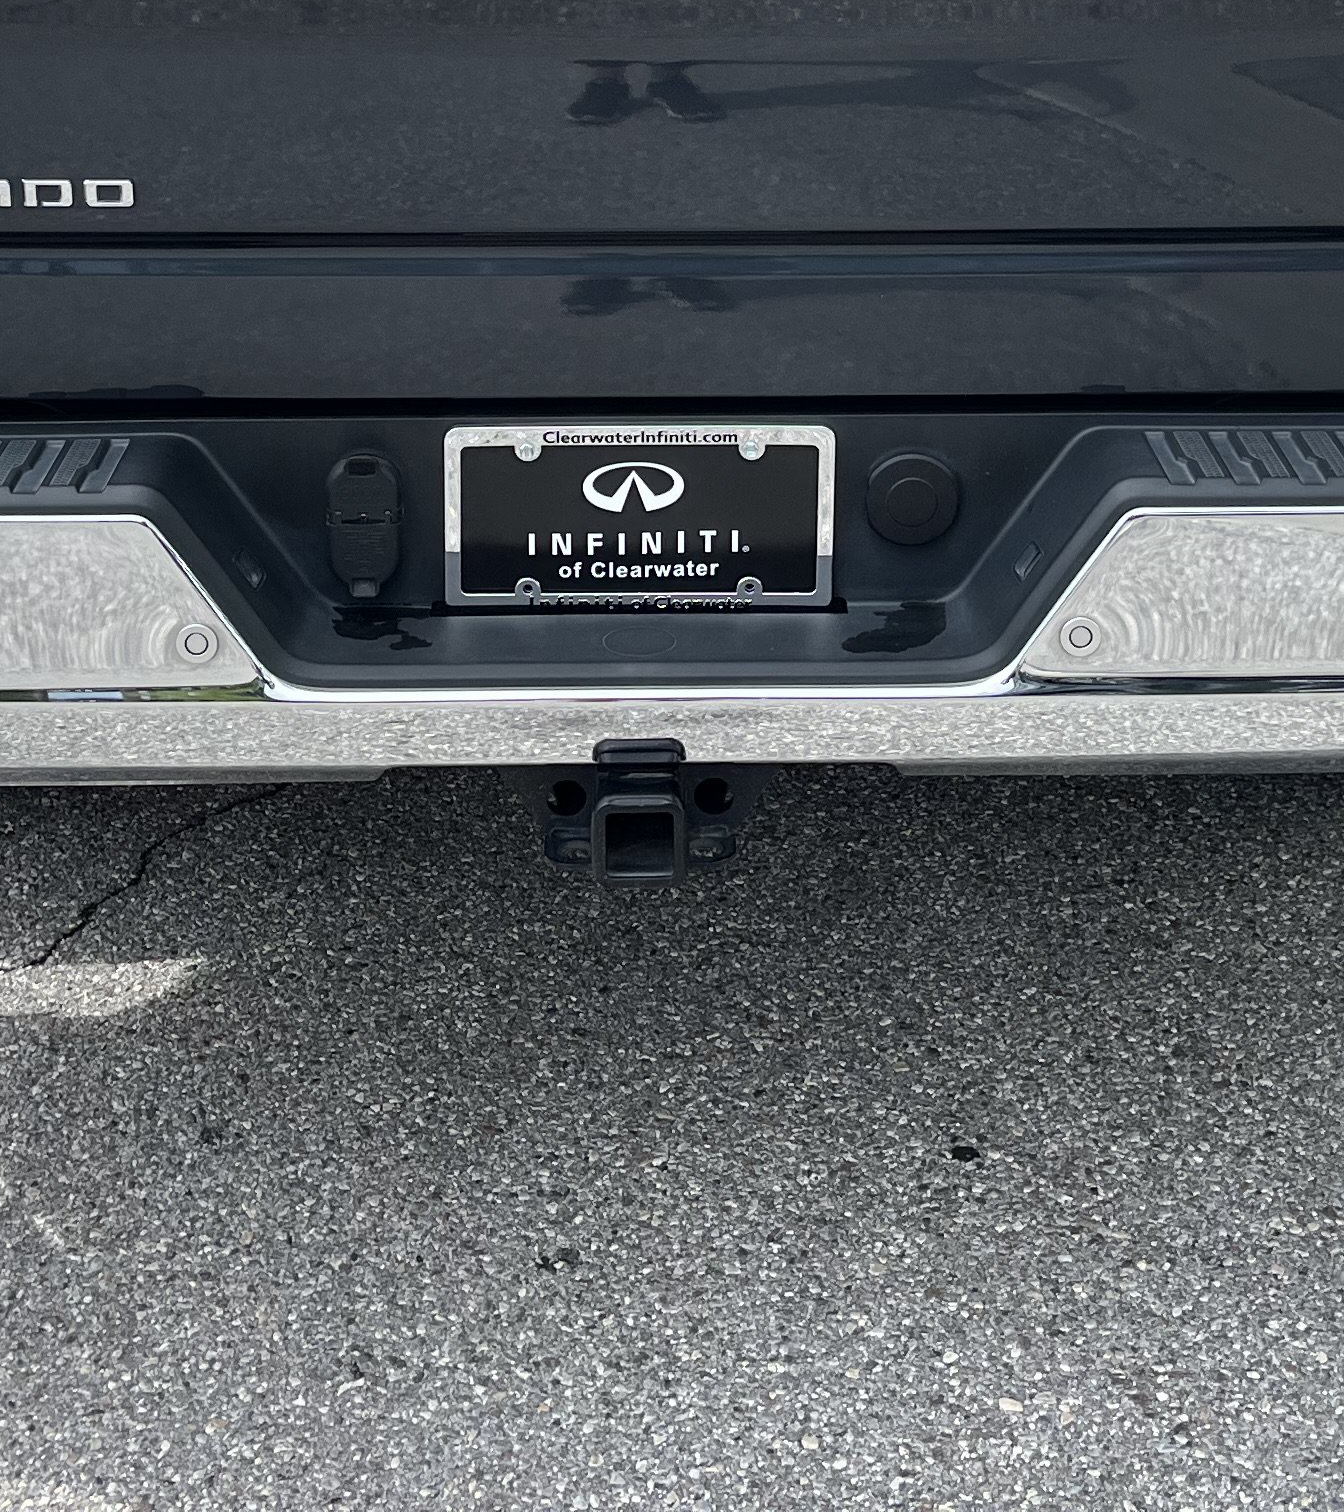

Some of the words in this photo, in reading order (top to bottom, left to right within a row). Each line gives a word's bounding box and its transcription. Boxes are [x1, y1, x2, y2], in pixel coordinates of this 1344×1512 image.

[542, 430, 738, 445] ClearwaterInfiniti.com
[558, 561, 582, 579] of
[590, 560, 720, 579] Clearwater
